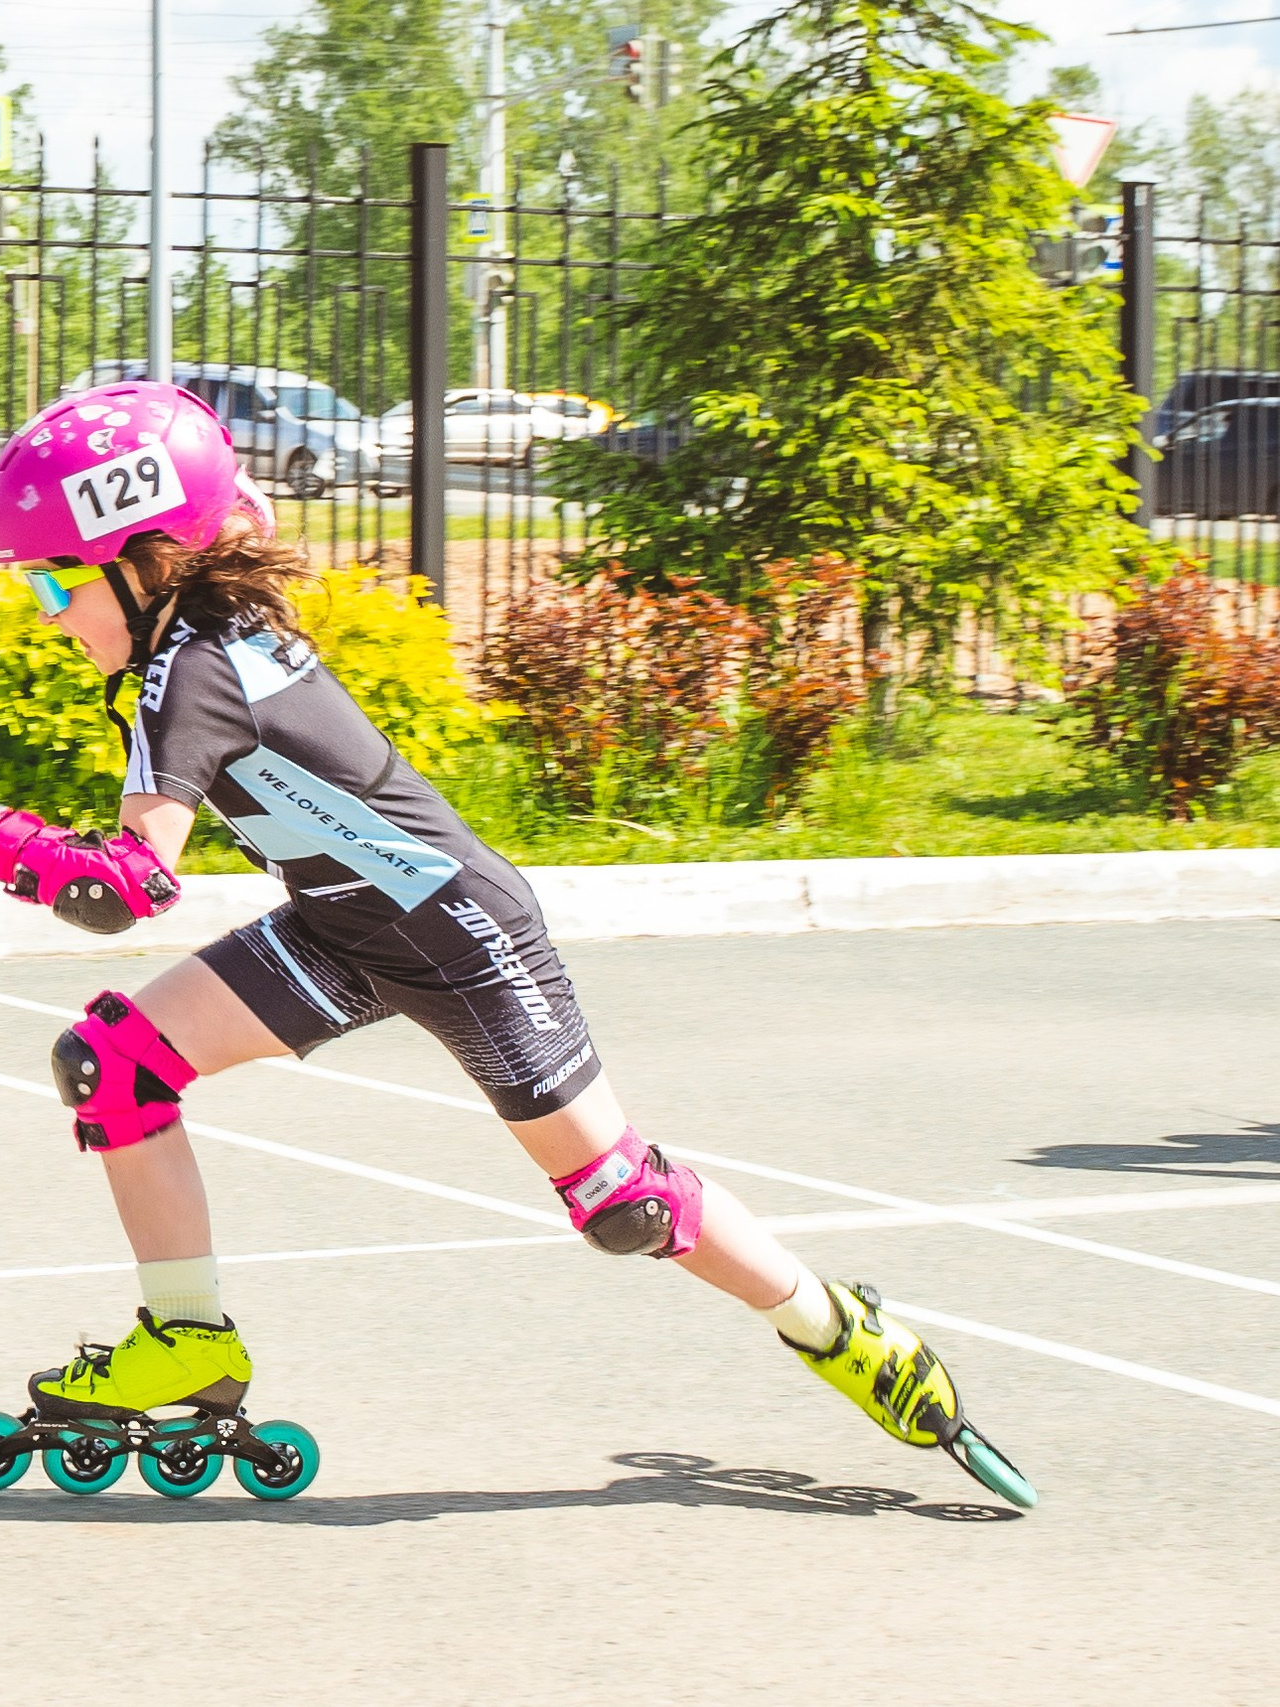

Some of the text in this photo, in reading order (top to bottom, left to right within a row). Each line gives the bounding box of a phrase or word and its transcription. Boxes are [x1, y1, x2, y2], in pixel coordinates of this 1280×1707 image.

[78, 456, 160, 519] 129
[258, 768, 289, 792] WE
[286, 791, 335, 825] LOVE
[333, 822, 359, 841] TO
[438, 896, 562, 1032] POWERSIDE
